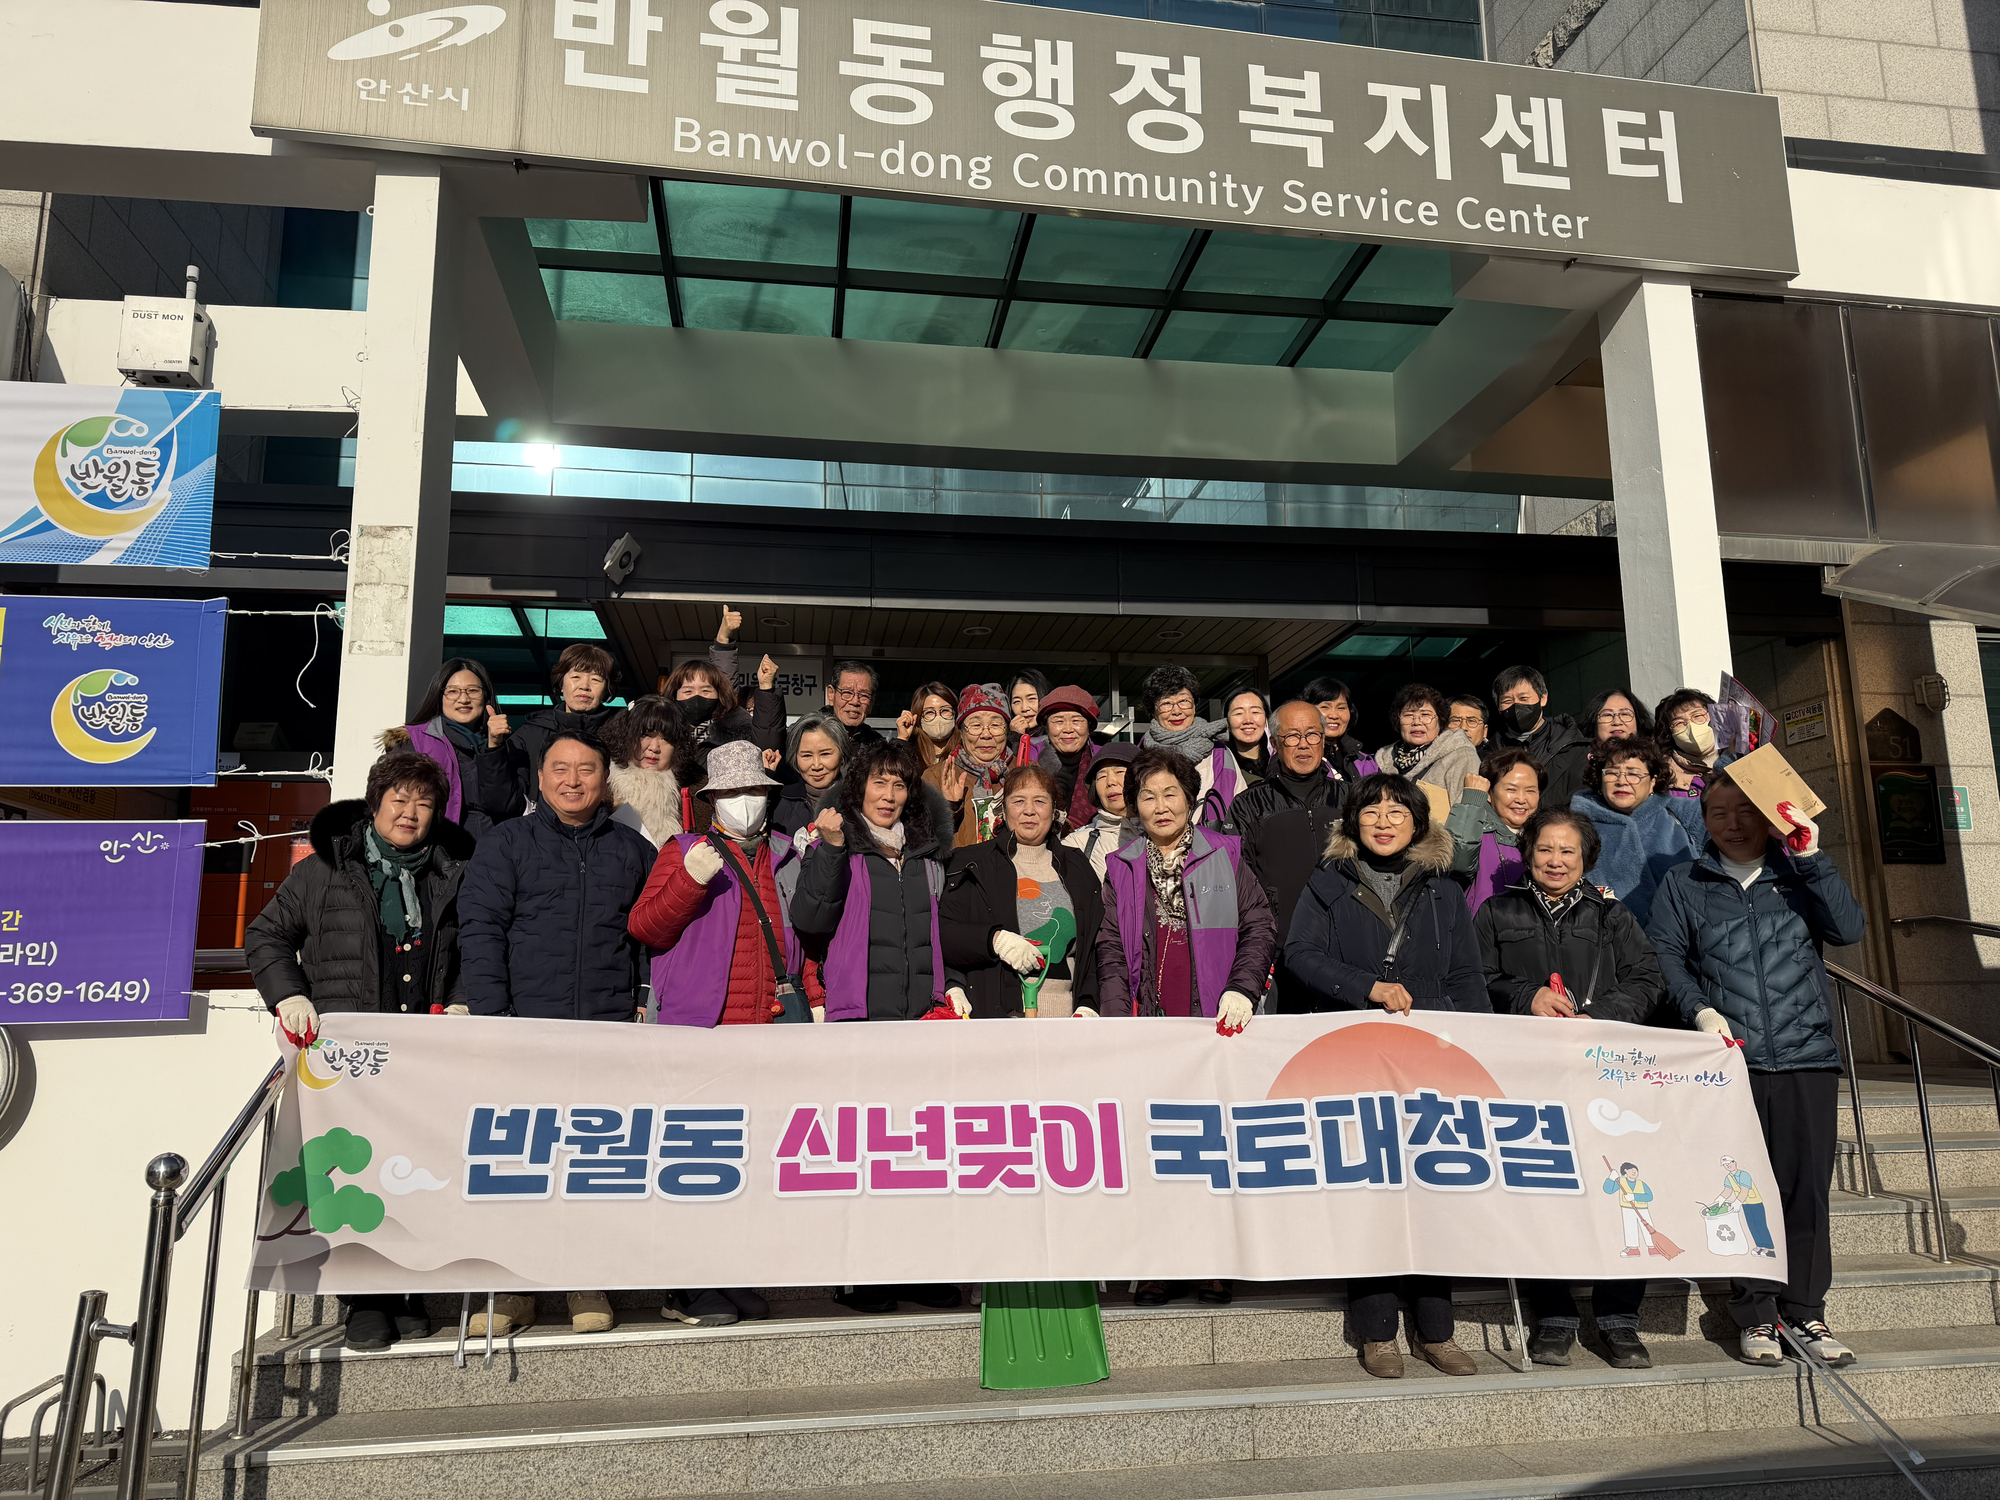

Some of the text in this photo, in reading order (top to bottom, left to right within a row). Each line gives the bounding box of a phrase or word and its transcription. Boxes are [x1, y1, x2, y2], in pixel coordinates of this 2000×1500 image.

[355, 75, 470, 112] 안산시
[554, 0, 1683, 204] 반월동행정복지센터
[673, 116, 1590, 240] Banwol-dong Community Service Center
[132, 312, 184, 321] DUST MON
[106, 447, 157, 457] Banwol-dong
[70, 458, 157, 499] 반월동
[43, 612, 80, 635] 시민과
[53, 632, 174, 650] 자유로운 혁신도시 안산
[79, 702, 147, 734] 반월동
[1890, 736, 1915, 759] 51
[29, 789, 81, 815] (DISASTER SHELTER)
[99, 830, 165, 864] 안산
[0, 909, 23, 932] 간
[323, 1047, 390, 1078] 반월동
[1584, 1045, 1628, 1069] 시민과
[1598, 1068, 1733, 1090] 자유로운 혁신도시 안산
[465, 1092, 1580, 1198] 반월동 신년맞이 국토대청결
